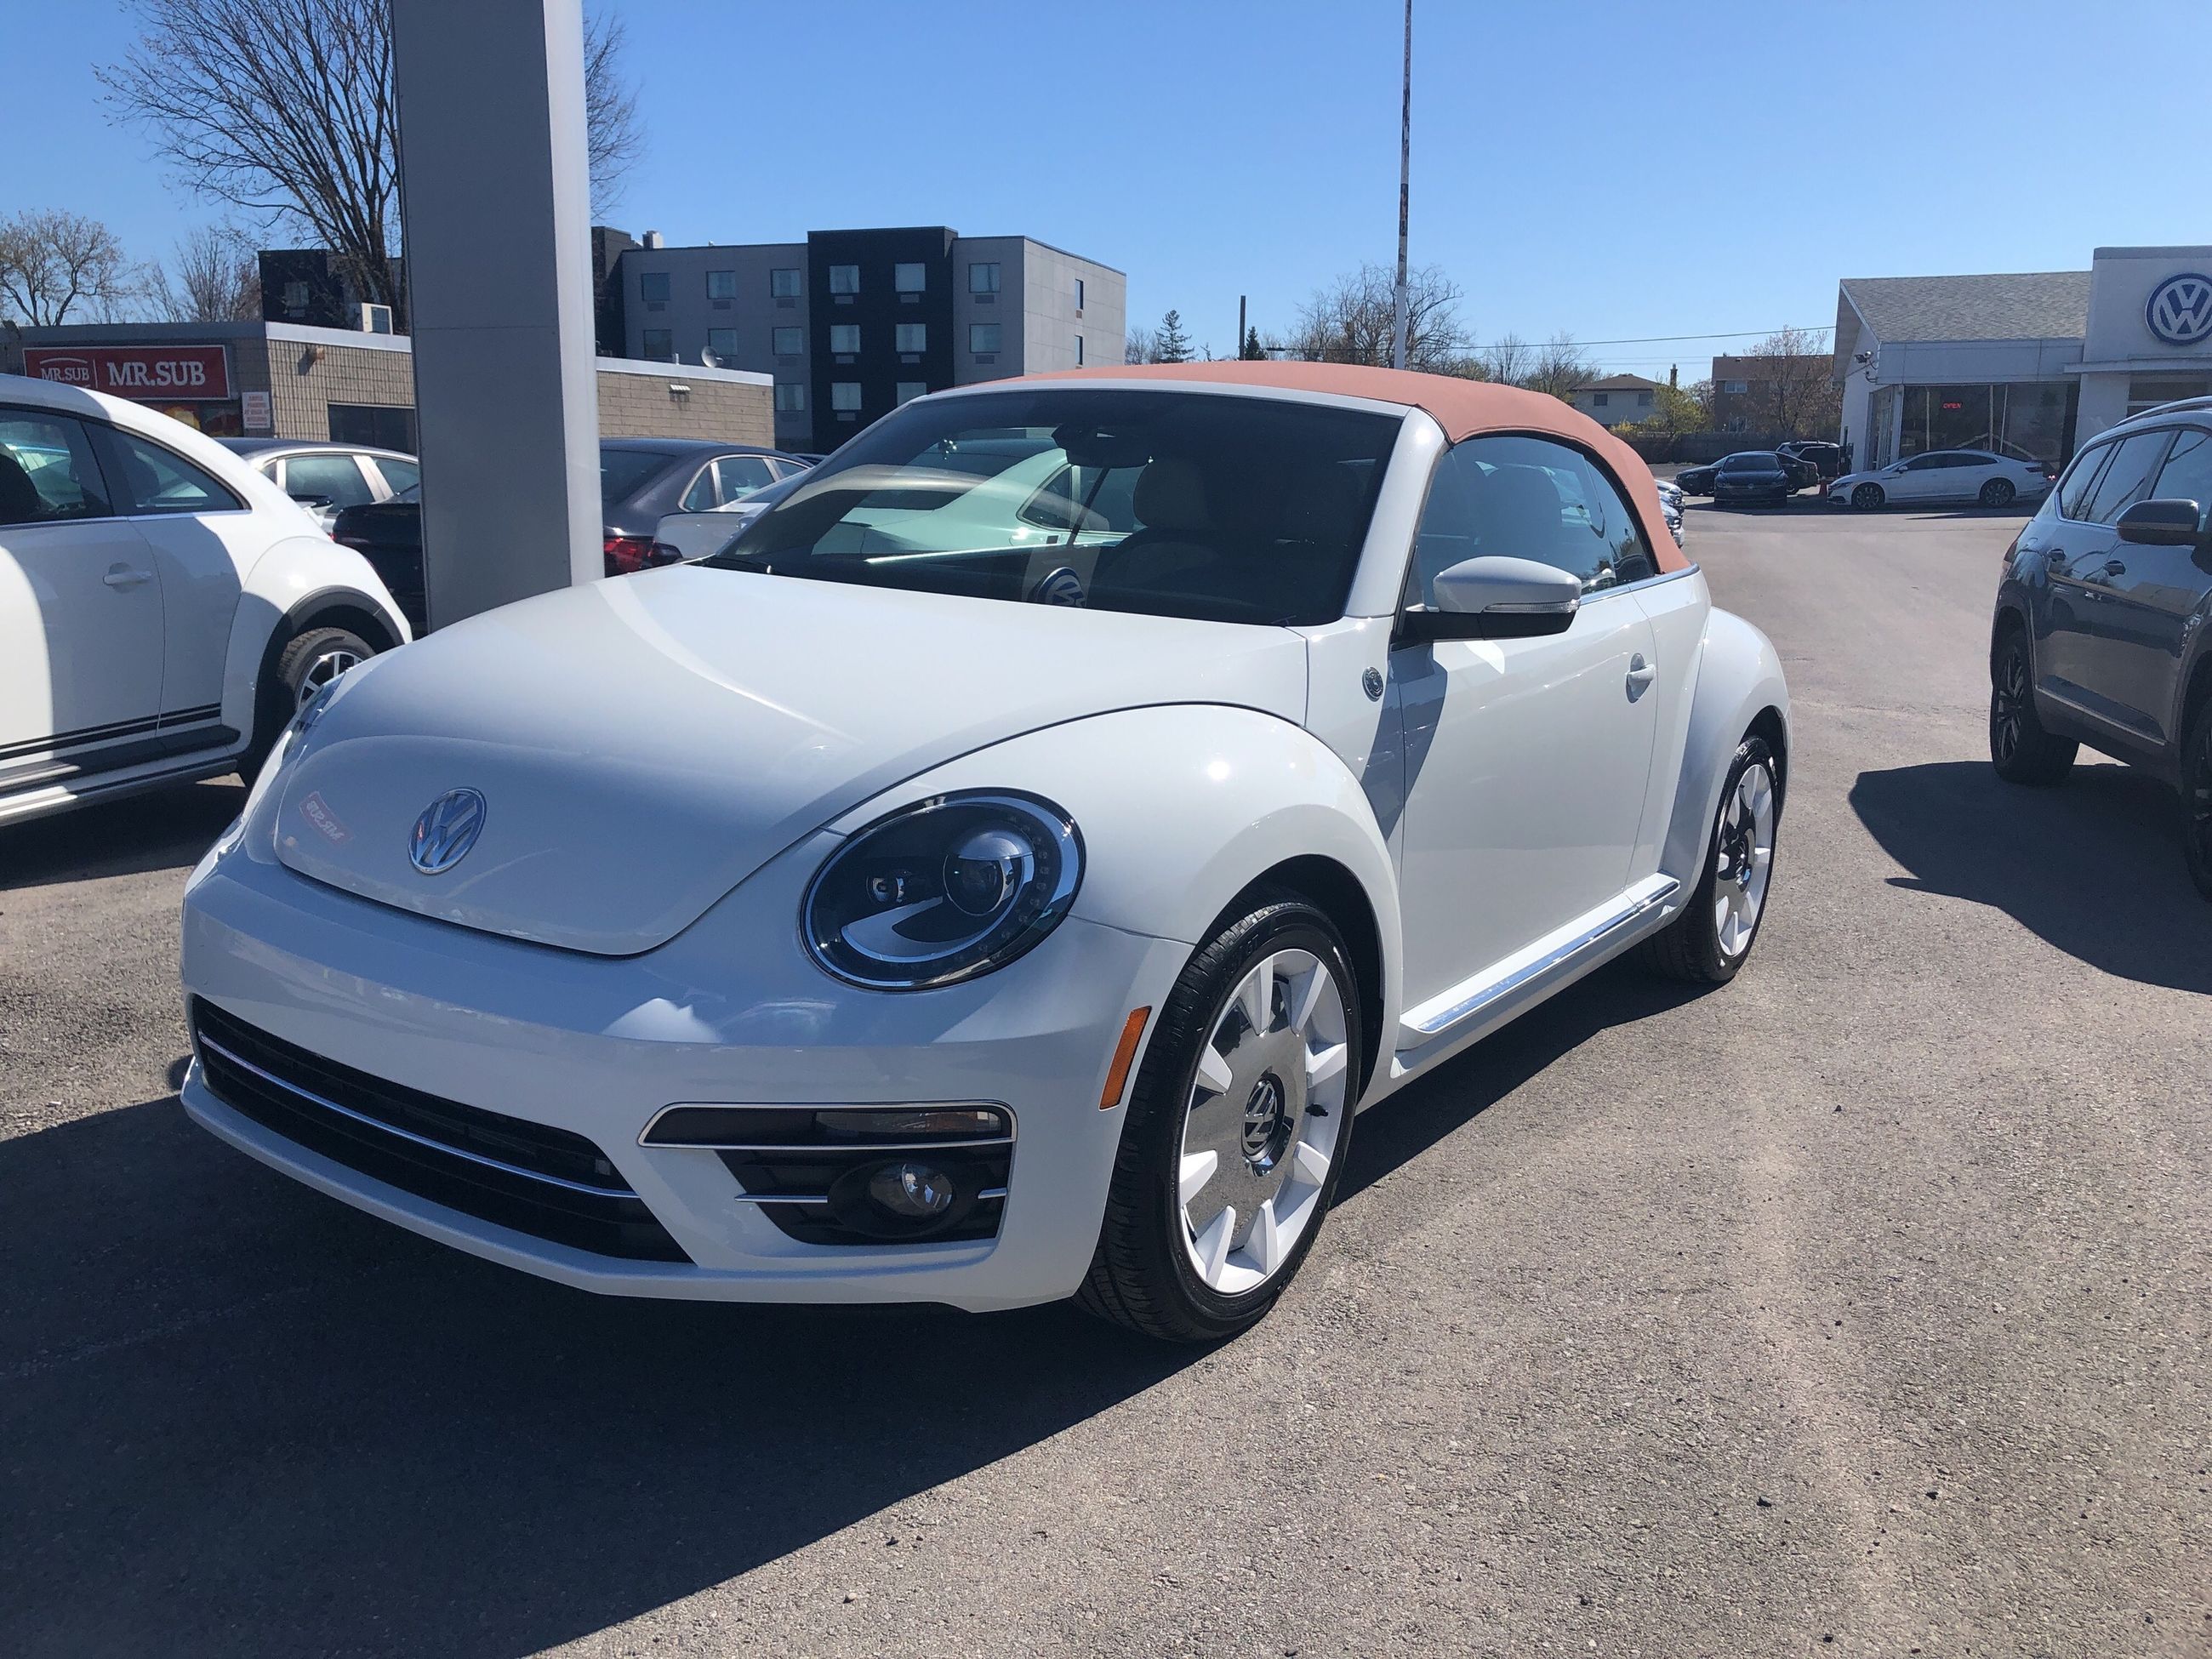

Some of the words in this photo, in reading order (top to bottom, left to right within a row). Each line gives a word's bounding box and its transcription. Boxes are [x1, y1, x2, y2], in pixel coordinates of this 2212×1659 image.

[2152, 277, 2212, 341] VW
[41, 367, 90, 381] MR.SUB
[106, 361, 206, 387] MR.SUB
[412, 790, 483, 872] VW
